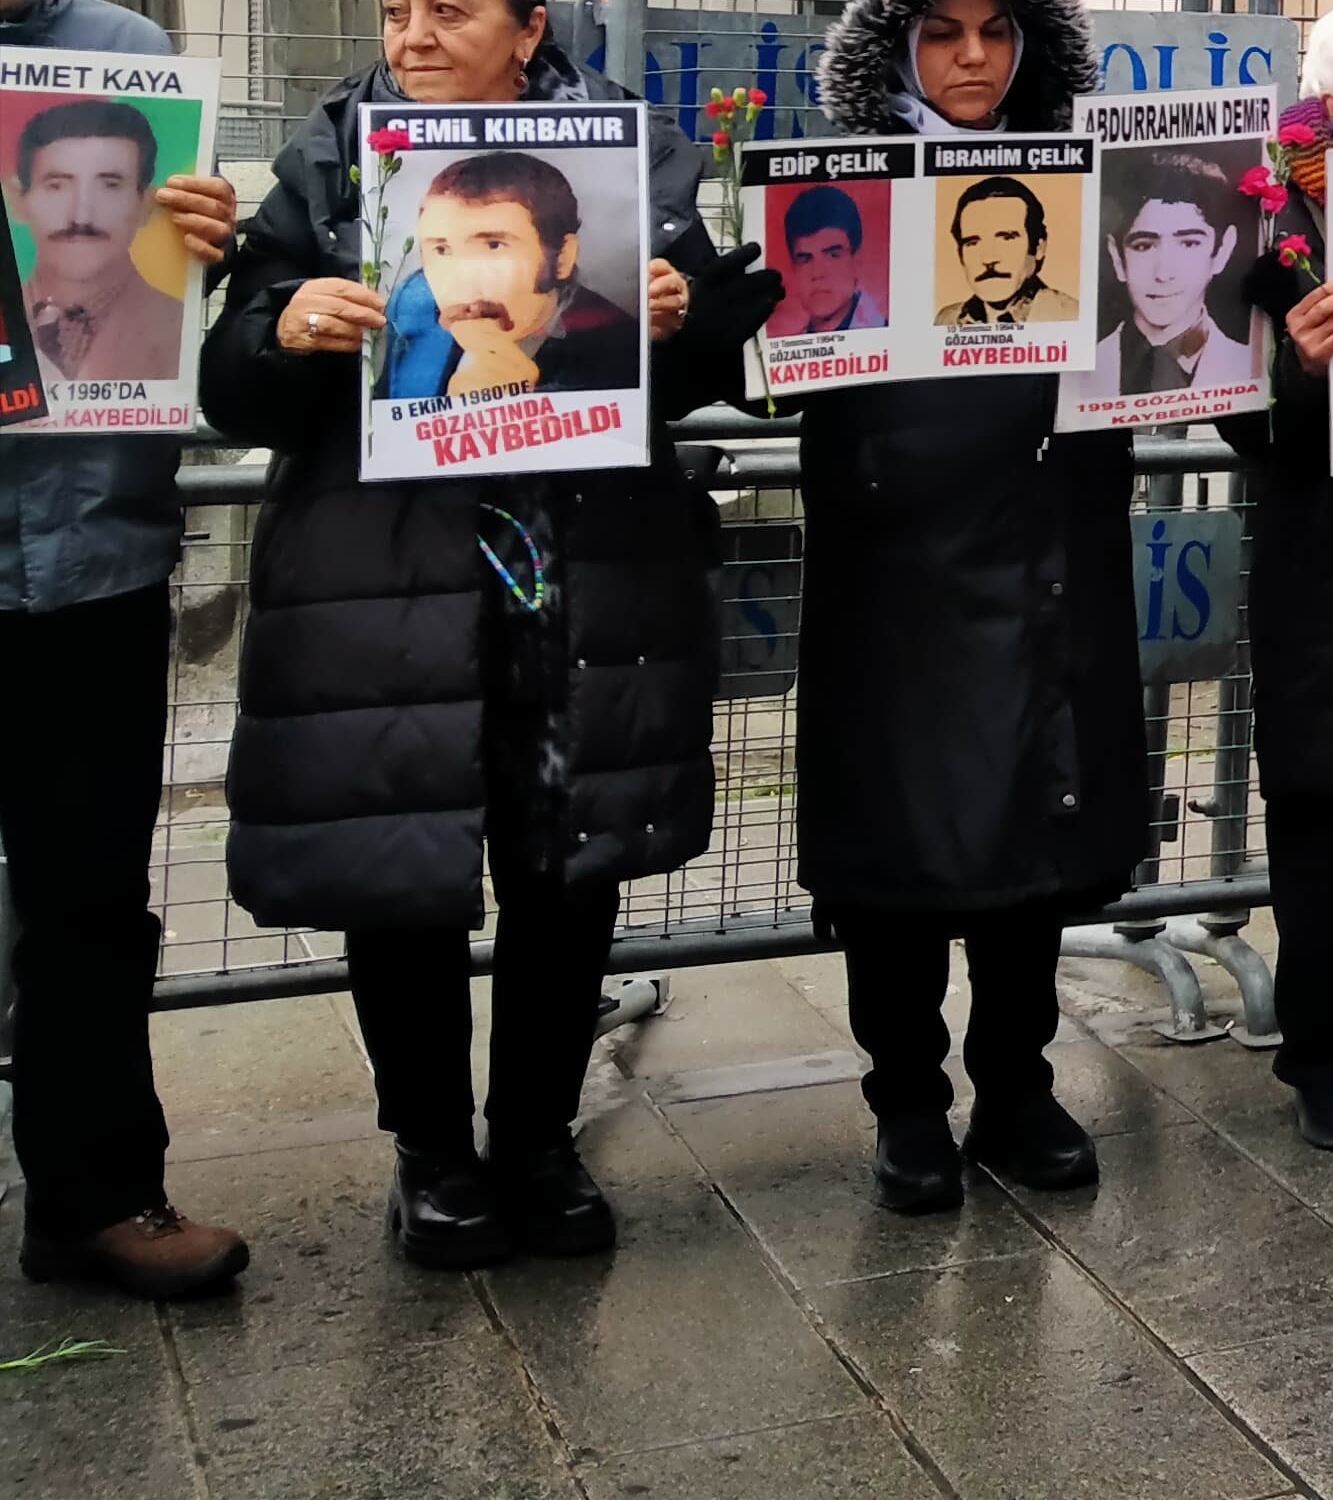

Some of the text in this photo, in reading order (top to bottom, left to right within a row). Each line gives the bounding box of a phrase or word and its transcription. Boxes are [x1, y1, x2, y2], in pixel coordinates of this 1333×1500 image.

[102, 67, 183, 95] KAYA
[484, 115, 625, 143] KIRBAYIR
[1085, 100, 1217, 143] ABDURRAHMAN
[769, 148, 889, 180] EDİP ÇELİK
[935, 143, 1085, 171] İBRAHİM ÇELİK
[943, 340, 1067, 367] KAYBEDİLDİ
[945, 333, 1014, 346] GÖZALTINDA
[769, 345, 835, 364] GÖZALTINDA
[769, 349, 889, 385] KAYBEDİLDİ
[67, 382, 147, 401] 1996'DA
[391, 405, 403, 422] 8
[459, 380, 530, 408] 1980'DE
[1077, 383, 1260, 413] 1995 GÖZALTINDA
[63, 403, 190, 428] KAYBEDİLDİ
[414, 396, 555, 442] GÖZALTINDA
[1111, 400, 1233, 425] KAYBEDİLDİ
